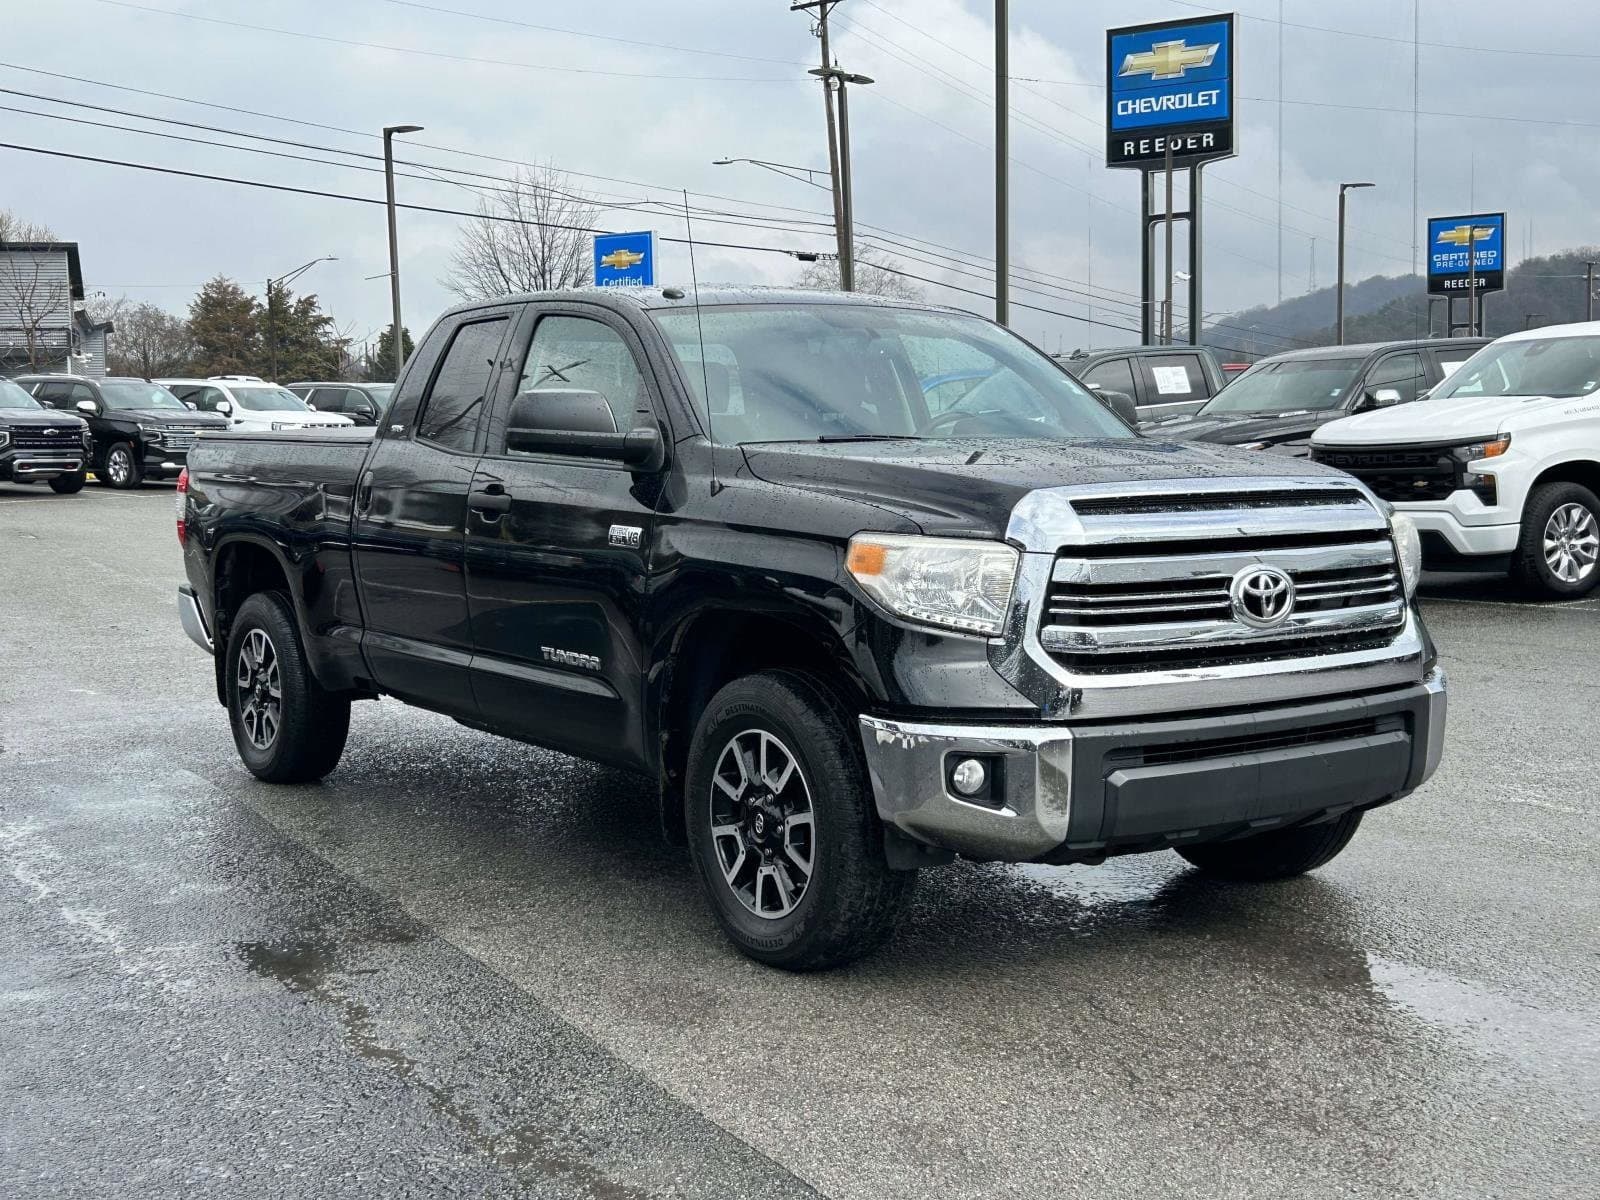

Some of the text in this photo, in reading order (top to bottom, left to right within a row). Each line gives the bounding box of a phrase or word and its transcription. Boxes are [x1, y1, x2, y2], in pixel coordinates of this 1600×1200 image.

[1117, 89, 1220, 116] CHEVROLET
[1124, 132, 1214, 156] REEDER
[1433, 250, 1497, 262] CERTIIED
[602, 275, 643, 287] Certified
[540, 646, 602, 671] TUNDRA
